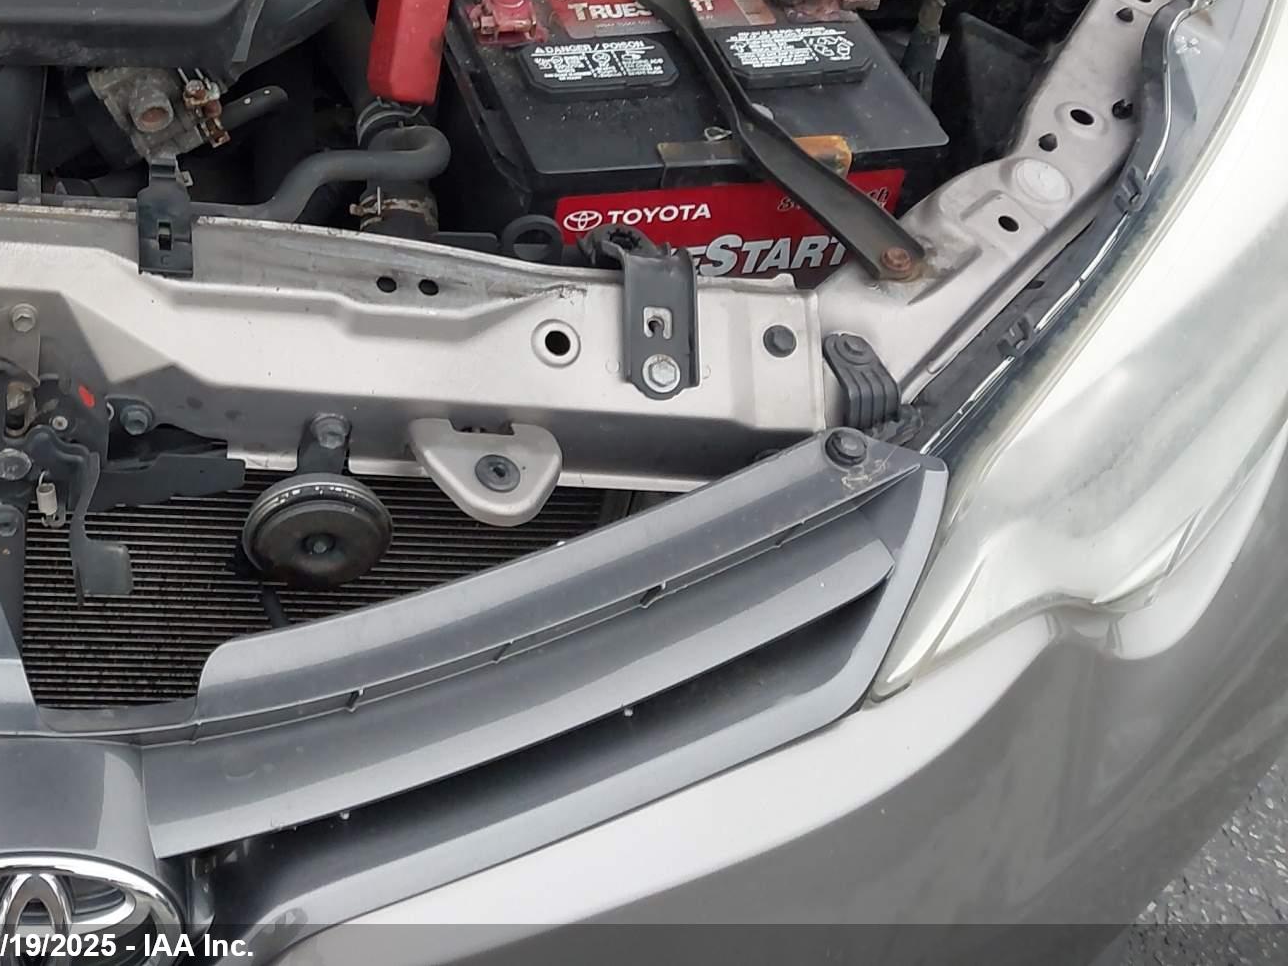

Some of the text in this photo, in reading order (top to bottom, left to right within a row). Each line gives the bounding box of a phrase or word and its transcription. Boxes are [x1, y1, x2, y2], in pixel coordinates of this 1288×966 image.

[545, 43, 591, 54] DANGER
[602, 40, 645, 50] POISON
[607, 203, 711, 225] TOYOTA
